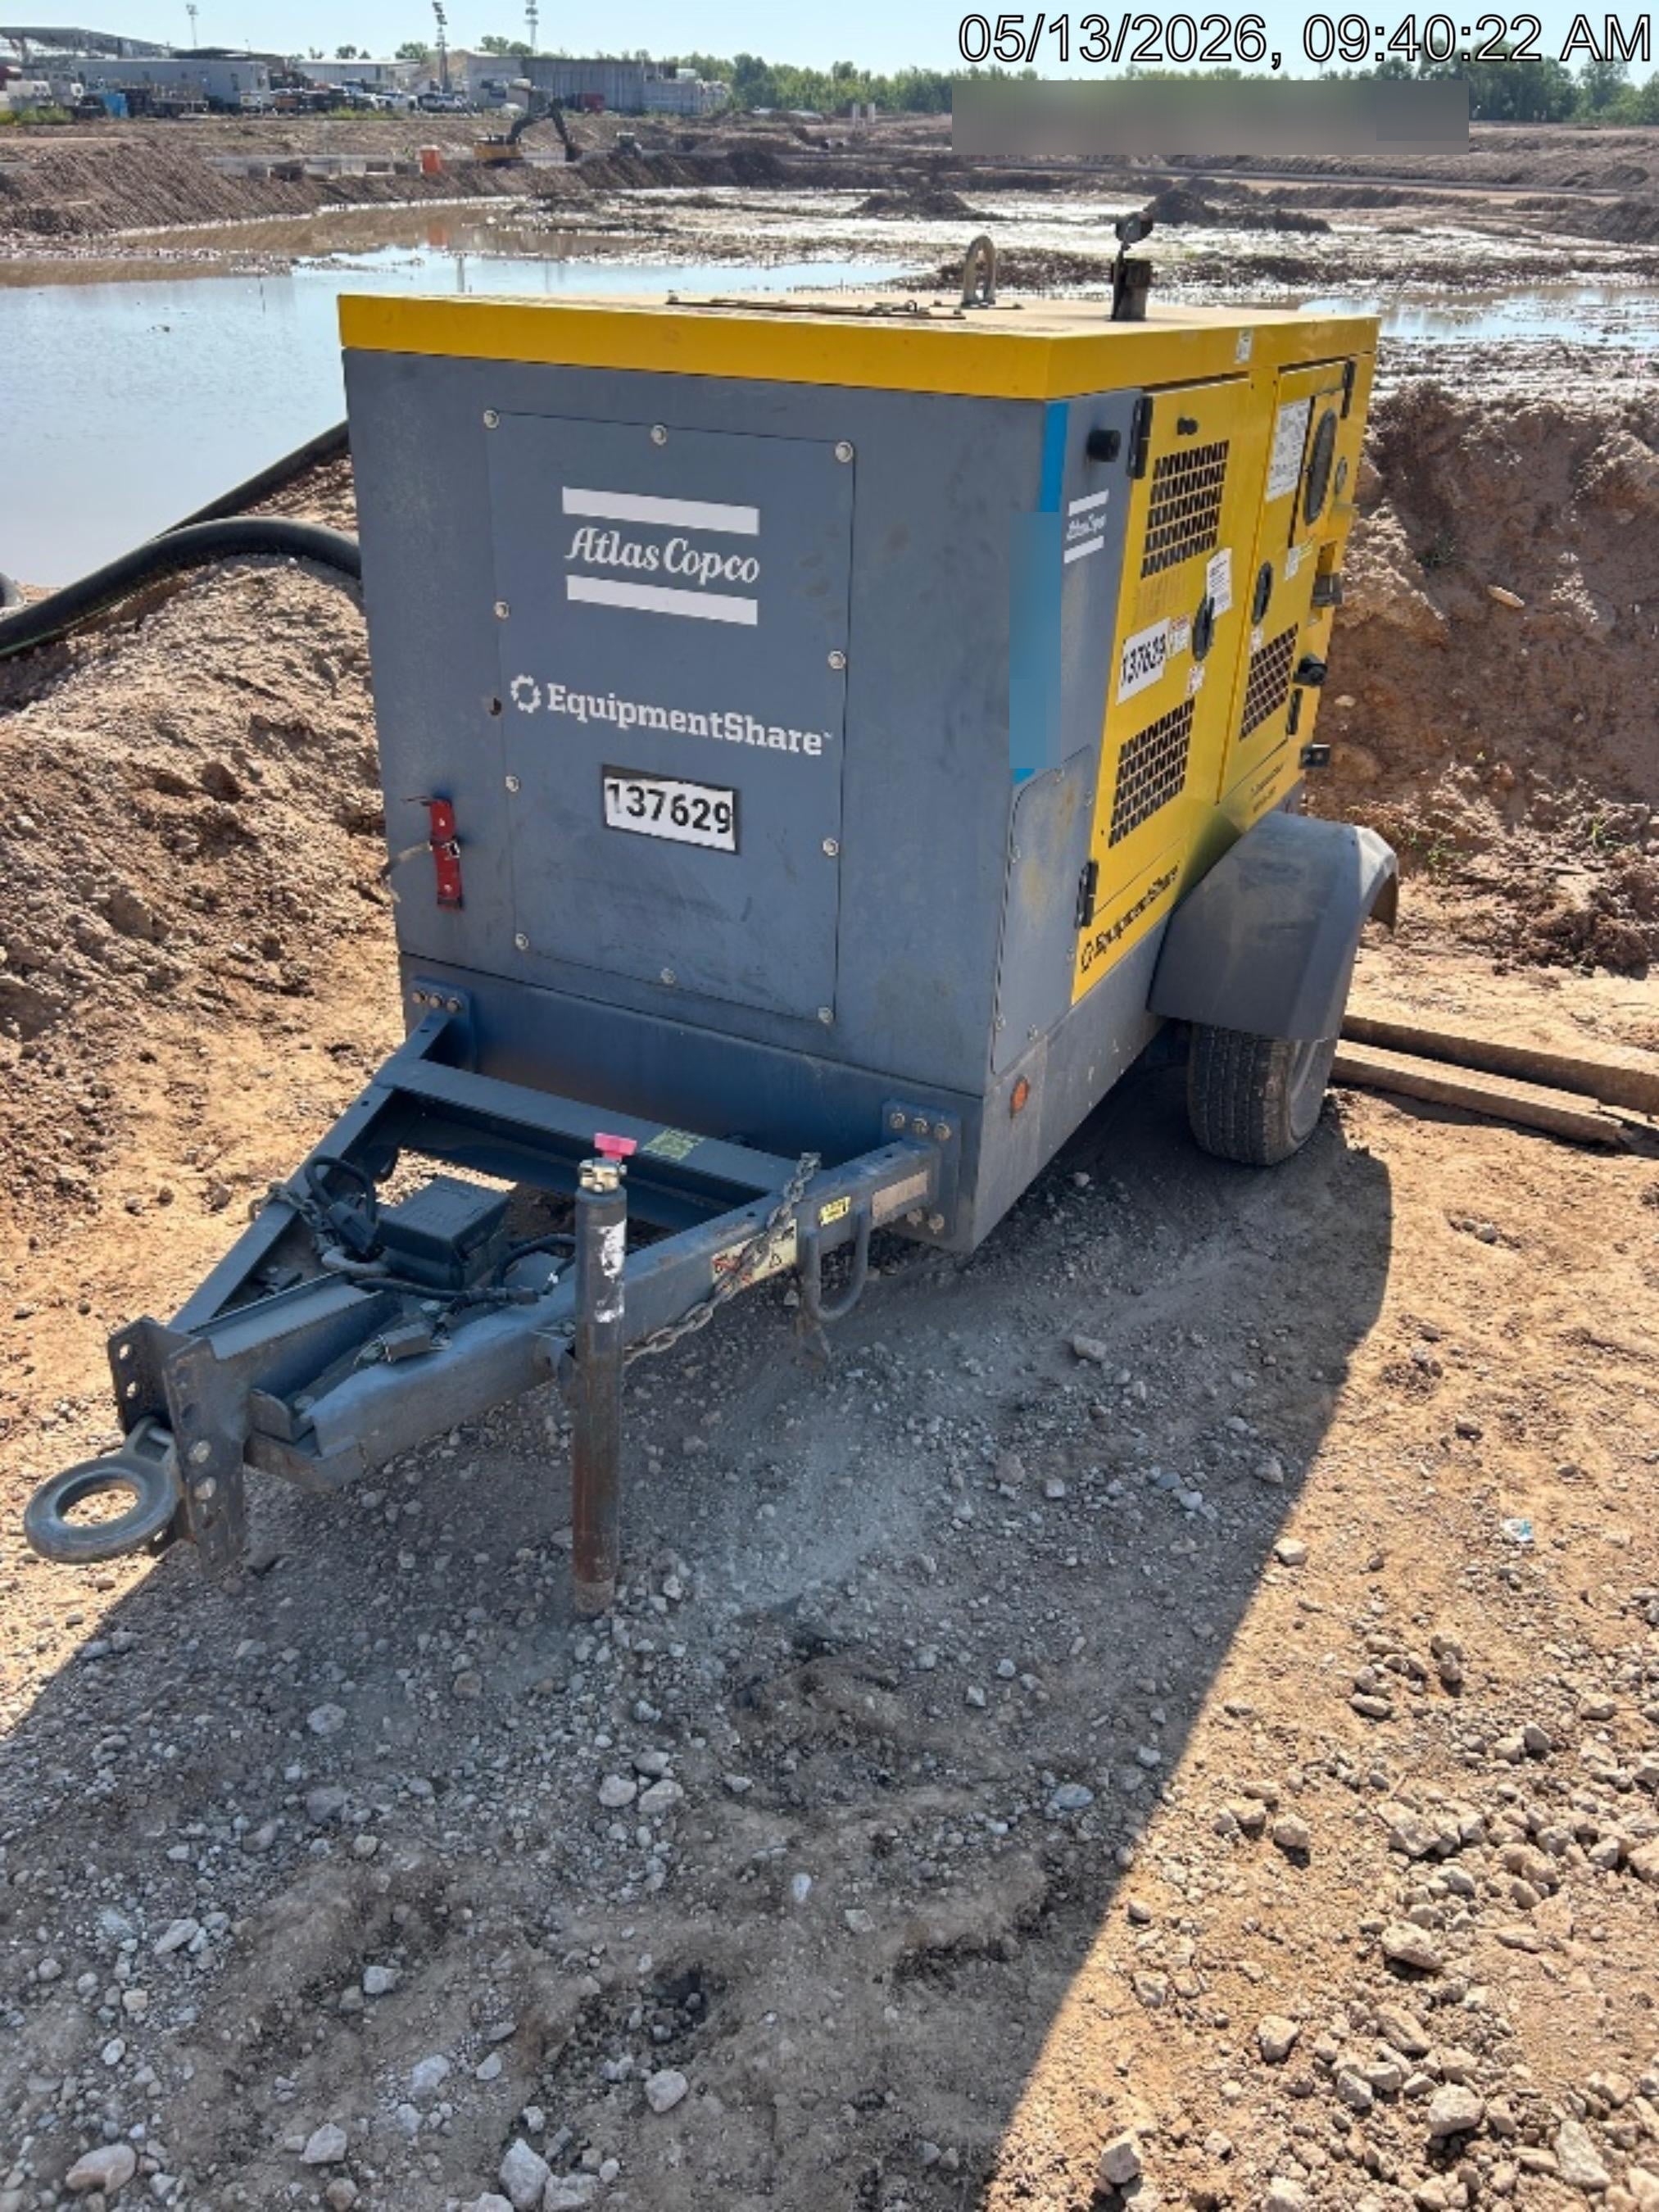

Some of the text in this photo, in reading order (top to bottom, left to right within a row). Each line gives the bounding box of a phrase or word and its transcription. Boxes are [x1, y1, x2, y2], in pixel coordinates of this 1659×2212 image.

[564, 526, 760, 586] Atlas Copco
[546, 682, 823, 755] EquipmentShare
[607, 783, 732, 834] 137629
